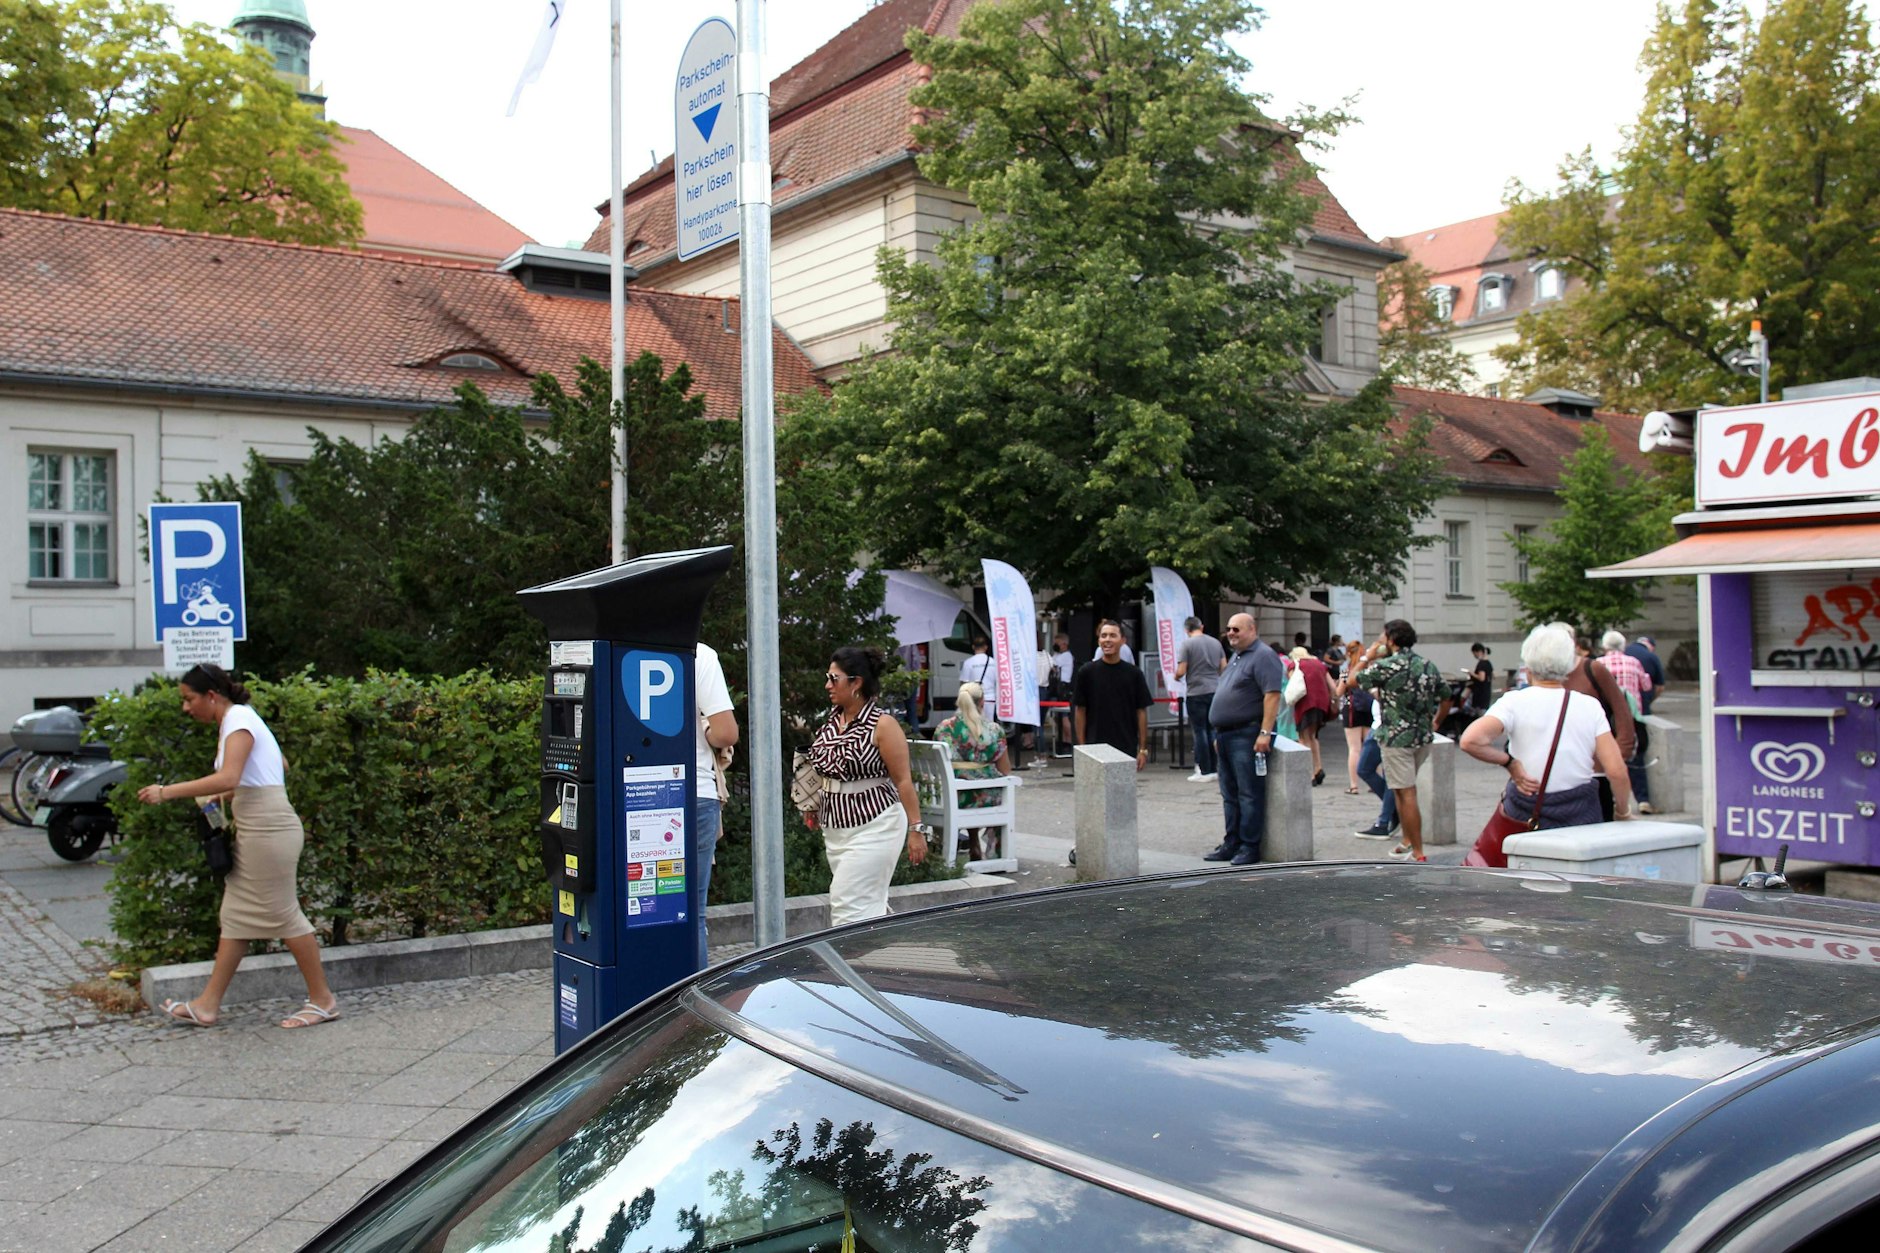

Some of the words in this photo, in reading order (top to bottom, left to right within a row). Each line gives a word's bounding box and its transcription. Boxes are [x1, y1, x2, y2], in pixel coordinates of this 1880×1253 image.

[680, 52, 734, 92] Parkschein-
[689, 79, 725, 112] automat
[683, 142, 734, 178] Parkschein
[686, 184, 704, 203] hier
[707, 171, 733, 193] lösen
[683, 199, 737, 230] Handyparkzone
[698, 221, 723, 243] 100026
[160, 519, 227, 605] P
[639, 659, 675, 720] P
[1752, 785, 1825, 799] LANGNESE
[1727, 806, 1854, 844] EISZEIT
